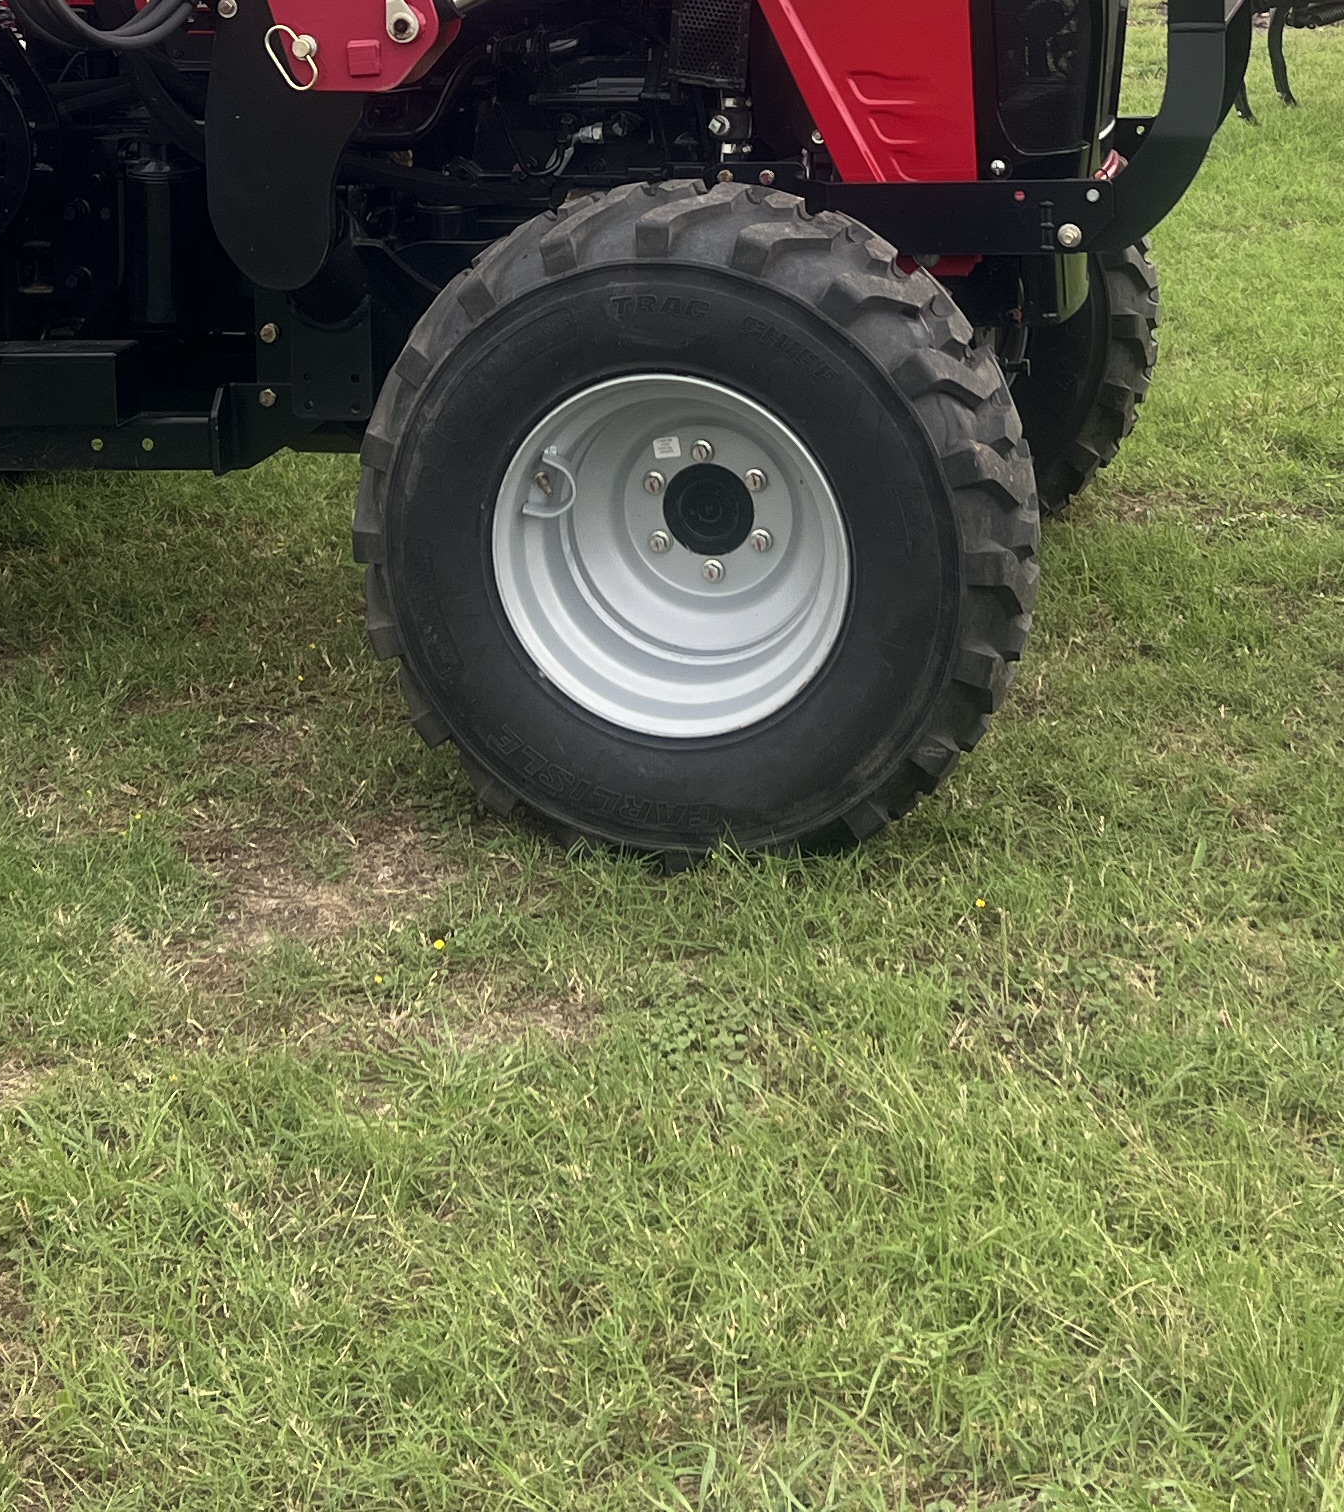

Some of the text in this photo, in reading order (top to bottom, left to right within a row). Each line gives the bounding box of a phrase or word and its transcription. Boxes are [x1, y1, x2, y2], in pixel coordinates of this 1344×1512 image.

[609, 294, 841, 384] TRAC CHIEF
[490, 725, 723, 828] CARLISLE
